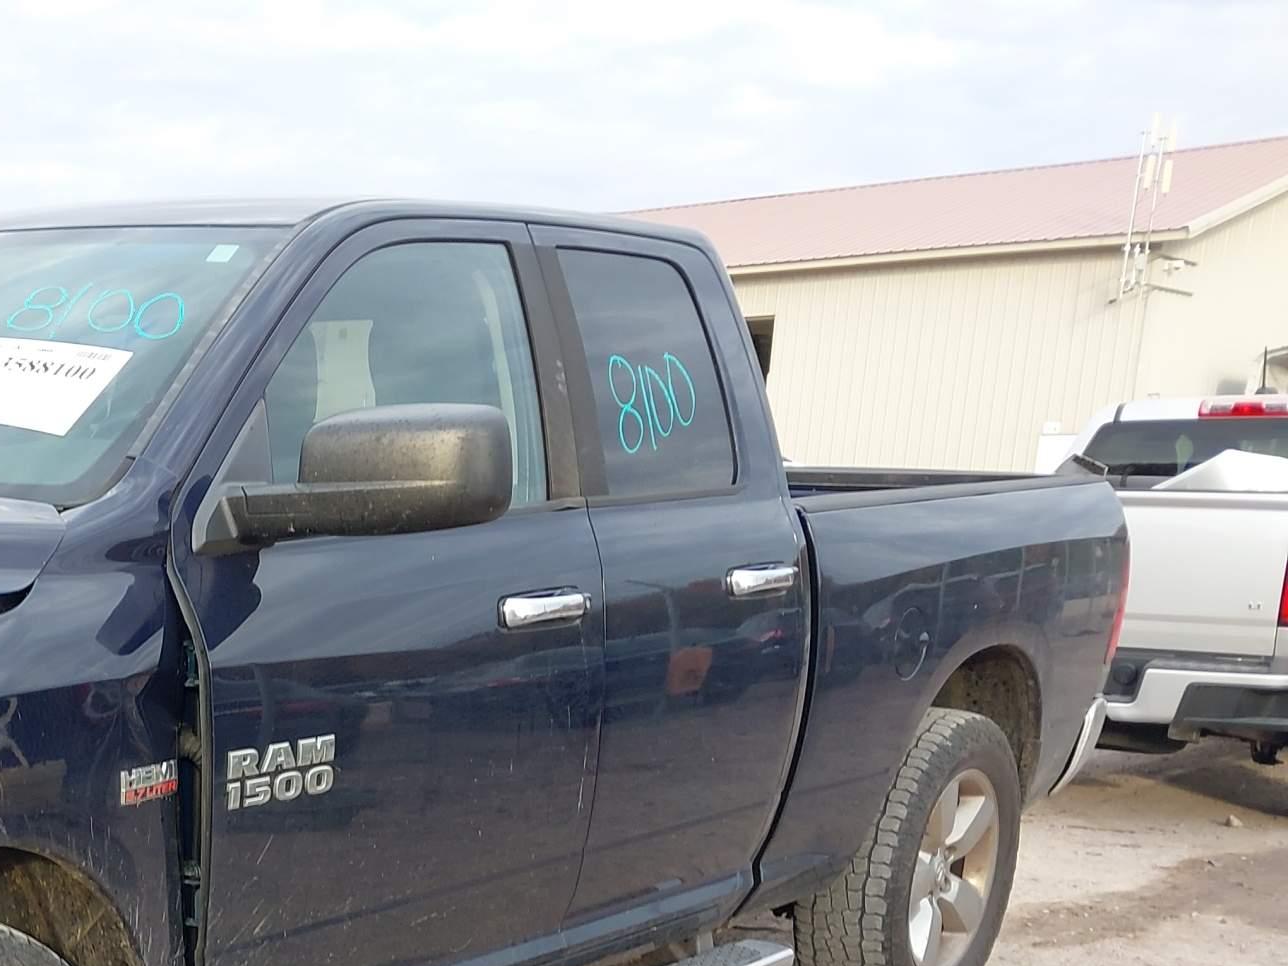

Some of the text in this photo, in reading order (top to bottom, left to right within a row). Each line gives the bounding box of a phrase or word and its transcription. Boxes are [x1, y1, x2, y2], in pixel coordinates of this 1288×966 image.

[7, 281, 185, 340] 8100
[608, 352, 696, 454] 8100
[227, 733, 336, 780] RAM
[227, 764, 335, 811] 1500
